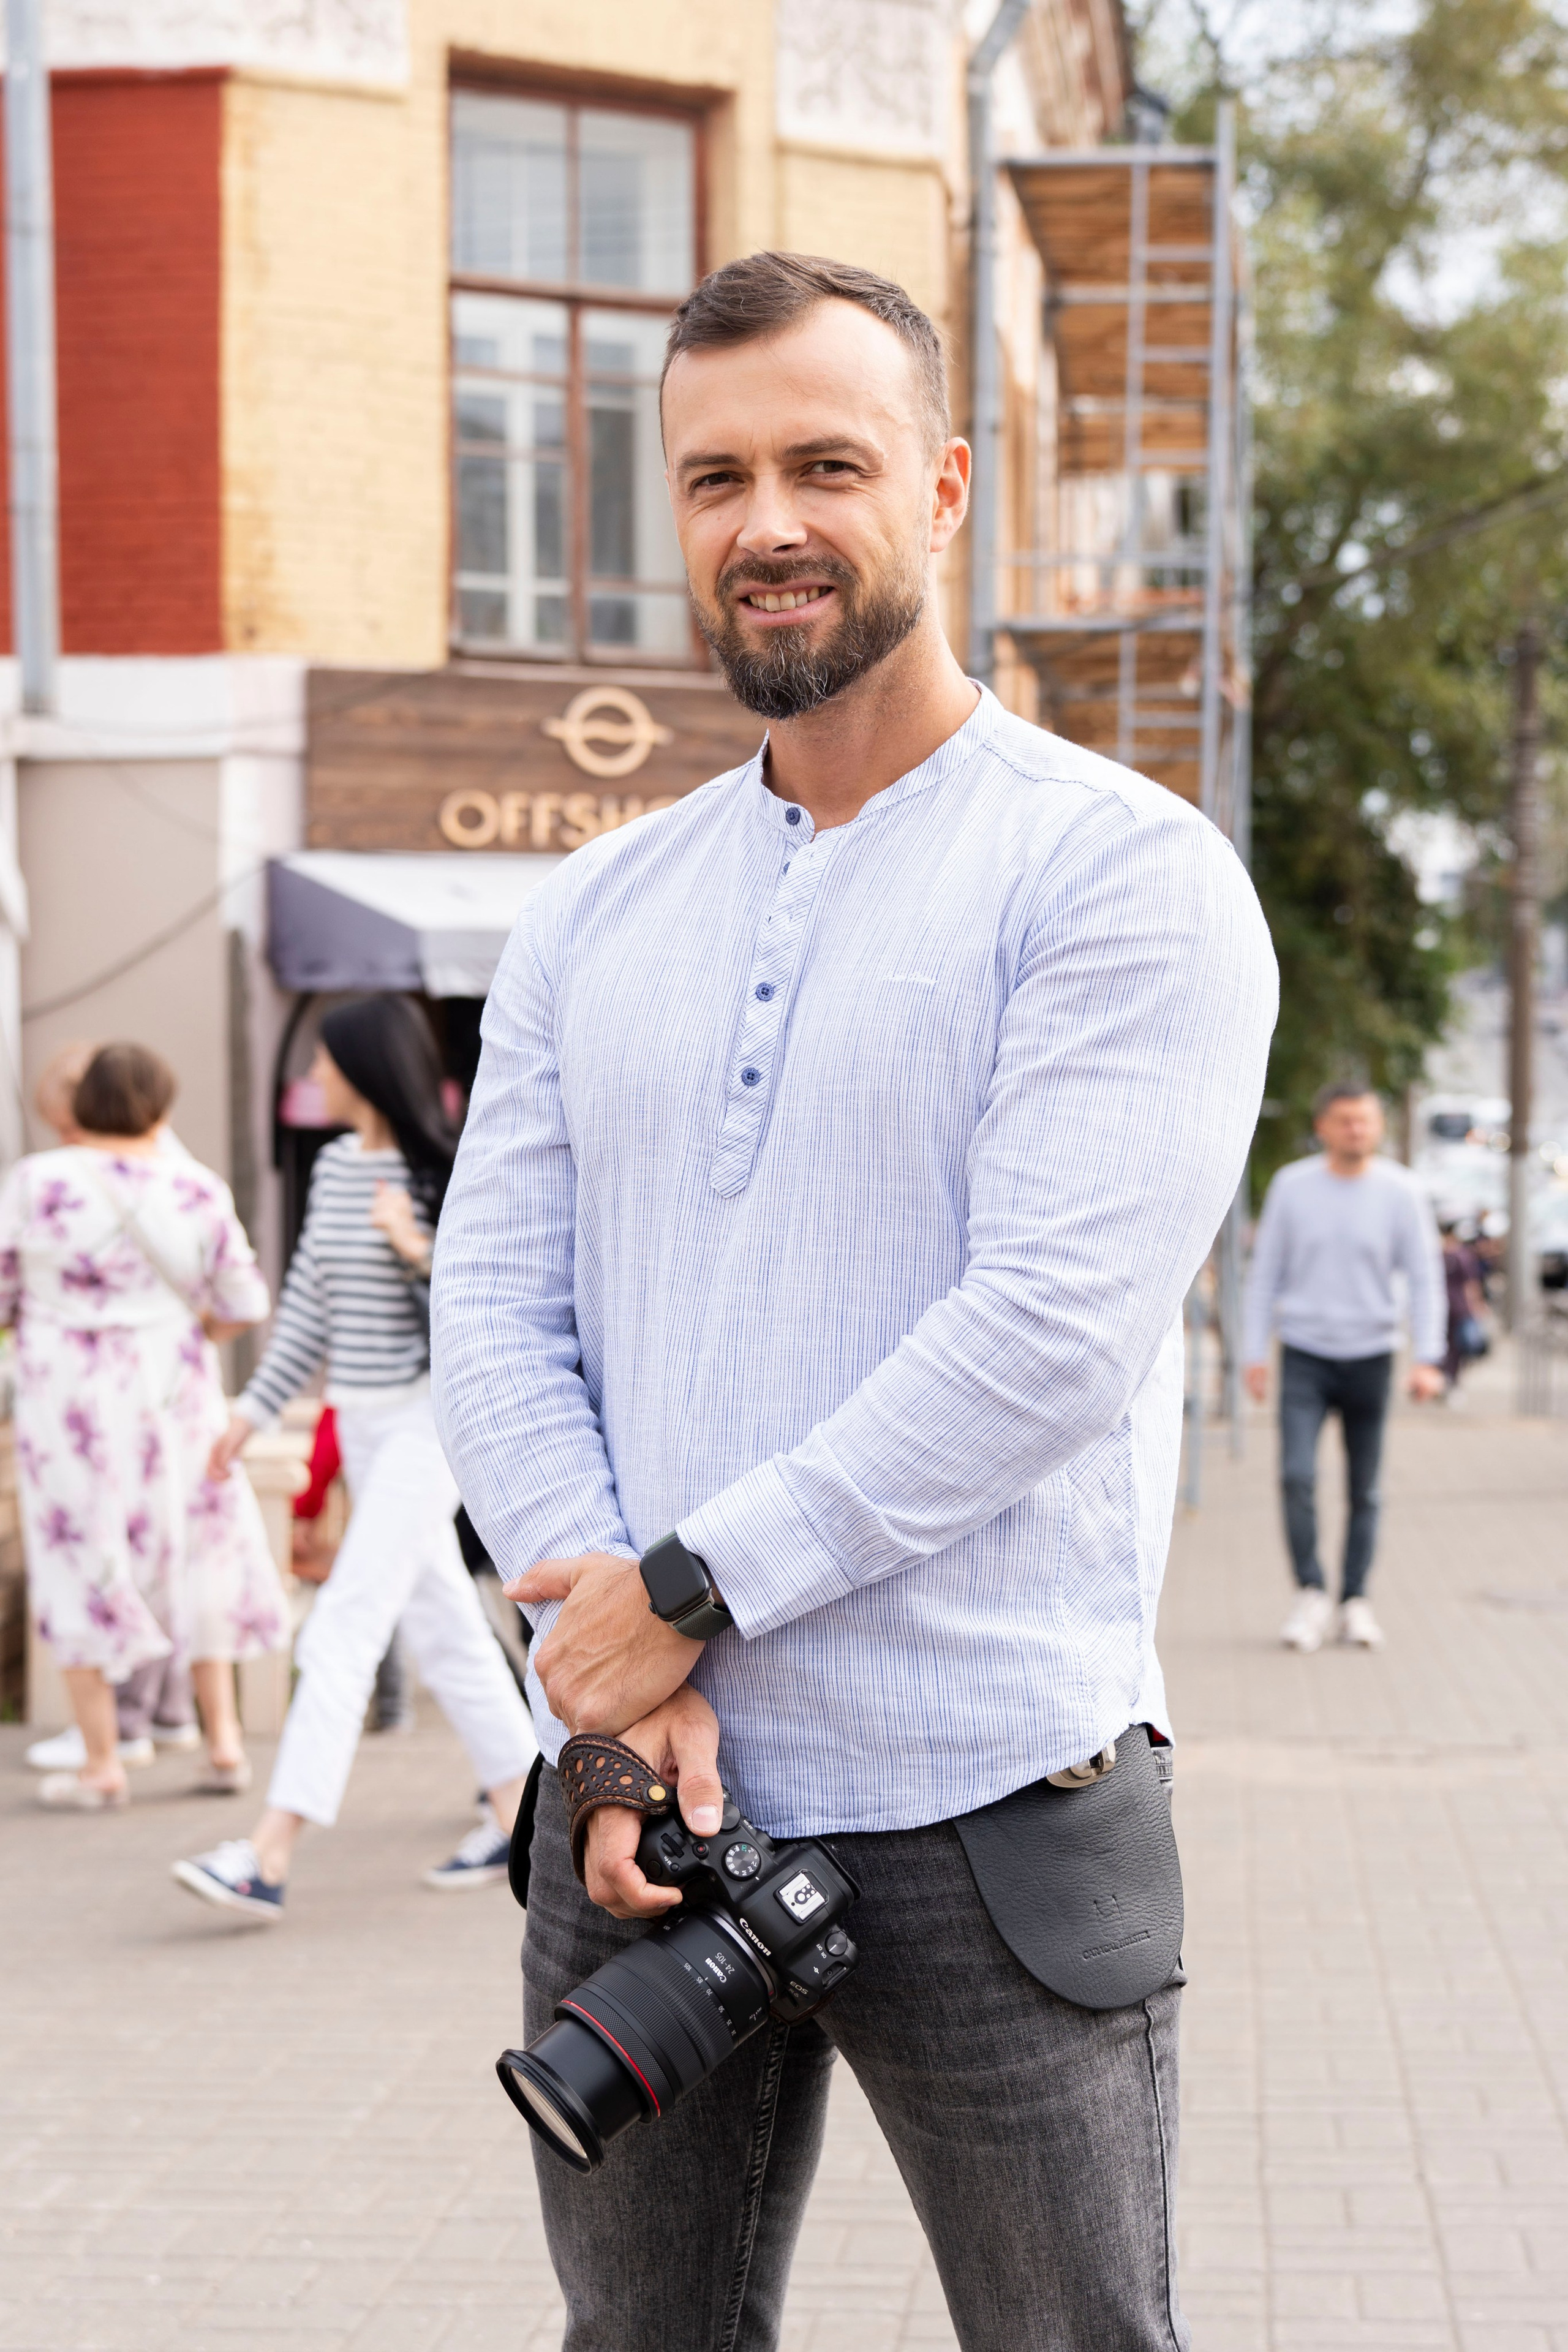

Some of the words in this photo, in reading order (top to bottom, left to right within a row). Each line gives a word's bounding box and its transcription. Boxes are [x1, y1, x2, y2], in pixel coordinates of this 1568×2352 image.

[739, 1918, 772, 1956] Canon
[683, 1962, 692, 1972] 105
[705, 1958, 727, 1983] Canon
[715, 1952, 735, 1974] 24-105
[790, 1981, 809, 1995] EOS
